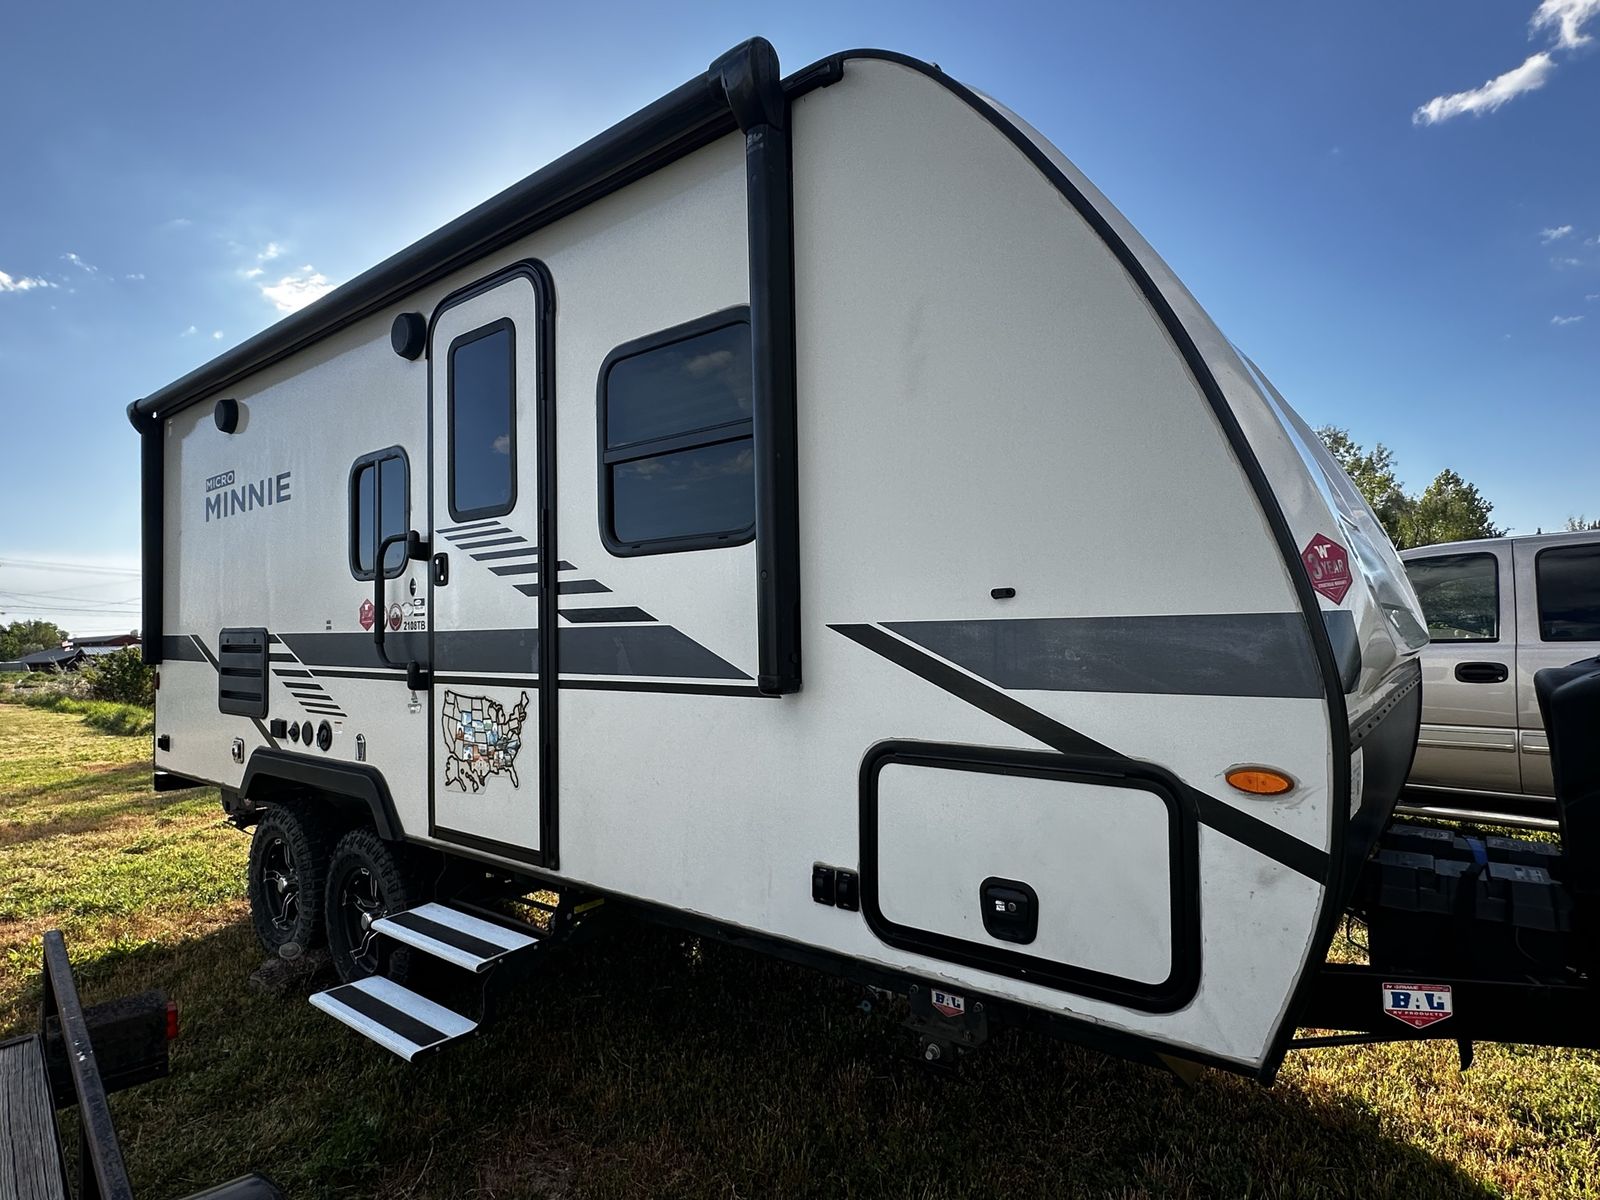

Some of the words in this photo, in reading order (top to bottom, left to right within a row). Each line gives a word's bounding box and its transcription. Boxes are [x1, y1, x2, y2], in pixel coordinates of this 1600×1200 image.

[206, 472, 234, 491] MICRO
[206, 471, 291, 522] MINNIE
[1391, 991, 1445, 1010] BAL
